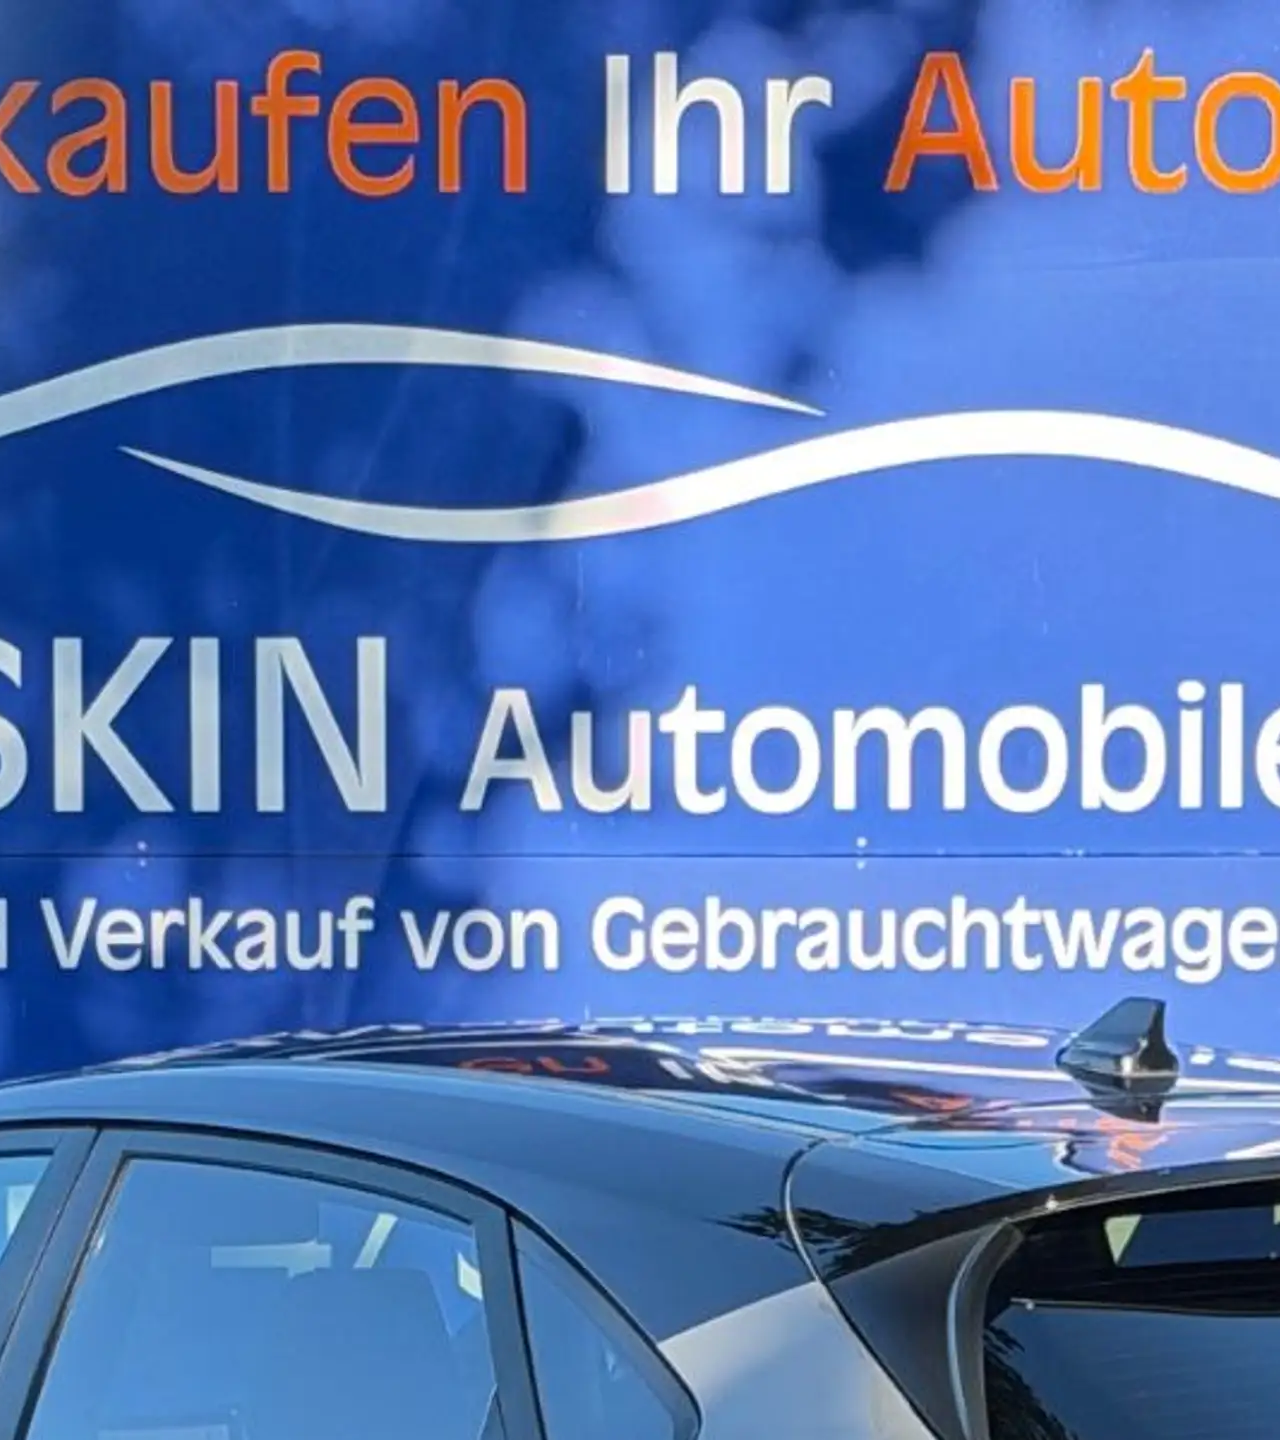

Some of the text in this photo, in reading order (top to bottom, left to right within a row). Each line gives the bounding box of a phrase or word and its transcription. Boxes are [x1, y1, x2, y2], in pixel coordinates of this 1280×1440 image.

[605, 52, 833, 195] Ihr
[41, 897, 375, 970] Verkauf
[401, 909, 560, 971] von
